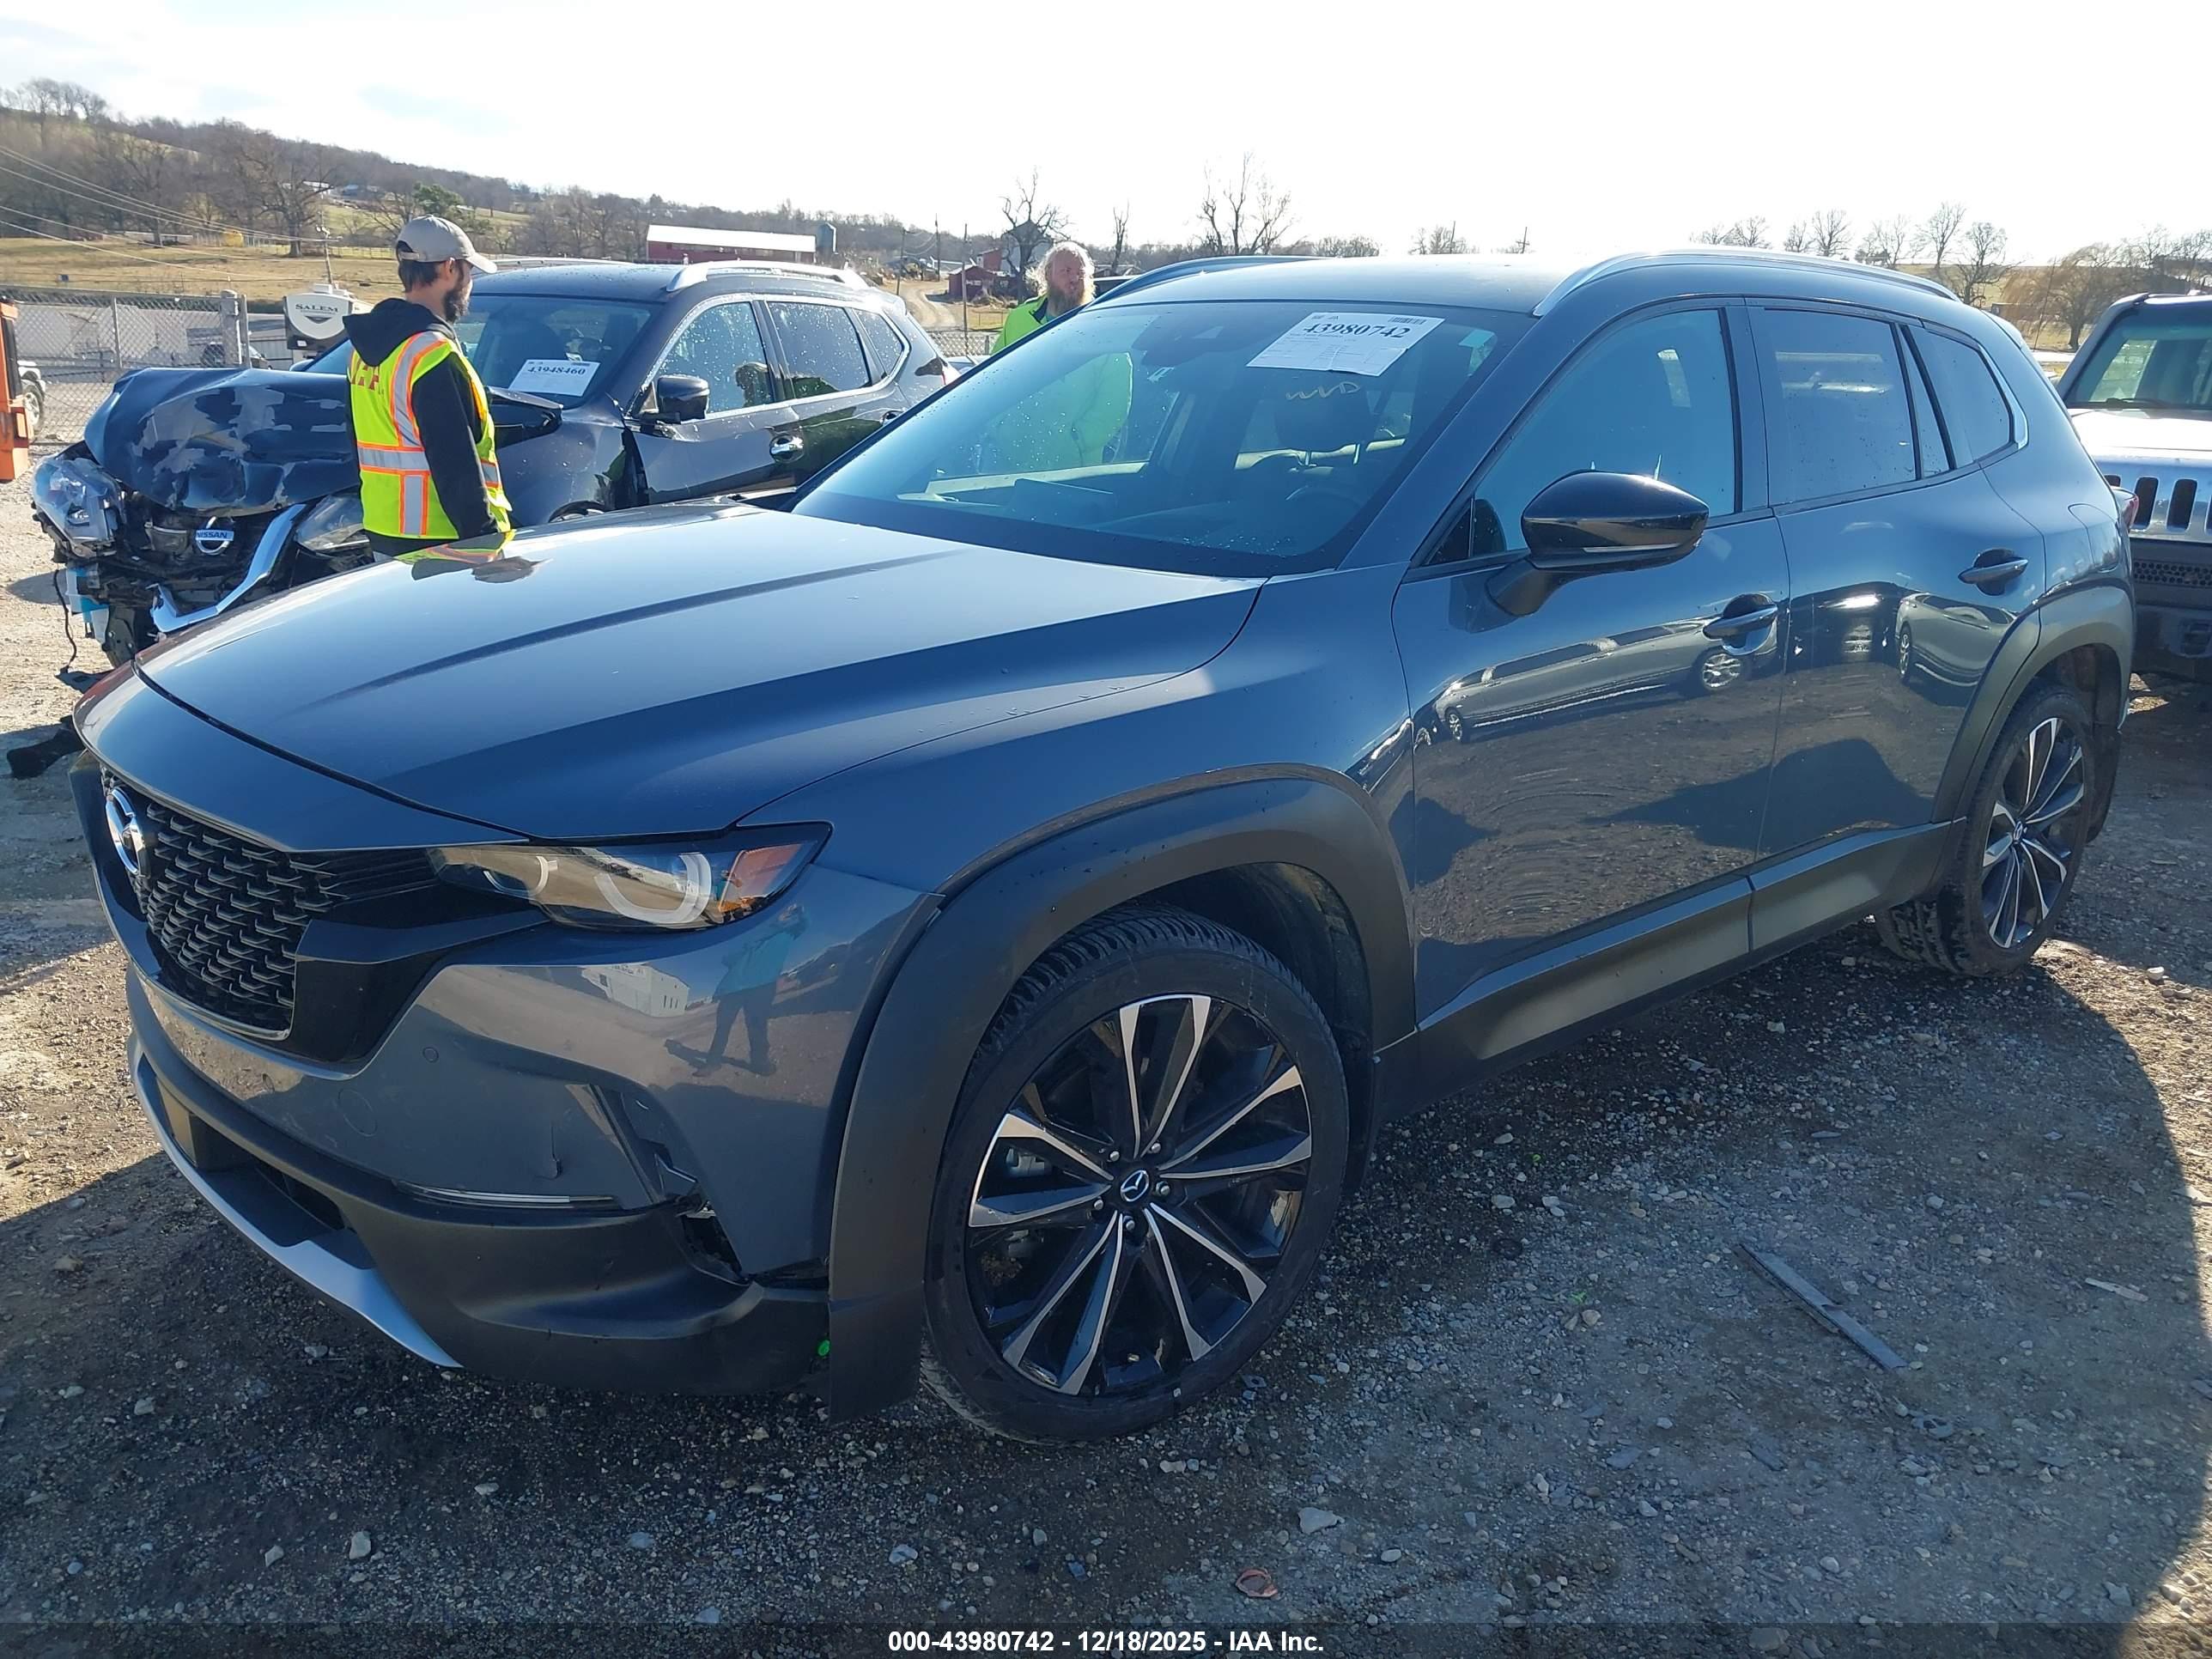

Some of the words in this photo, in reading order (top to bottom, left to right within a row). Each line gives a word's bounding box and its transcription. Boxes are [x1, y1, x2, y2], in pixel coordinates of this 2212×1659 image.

[295, 303, 338, 313] SALEM
[1303, 323, 1411, 338] 43980742
[528, 367, 586, 375] 43948460
